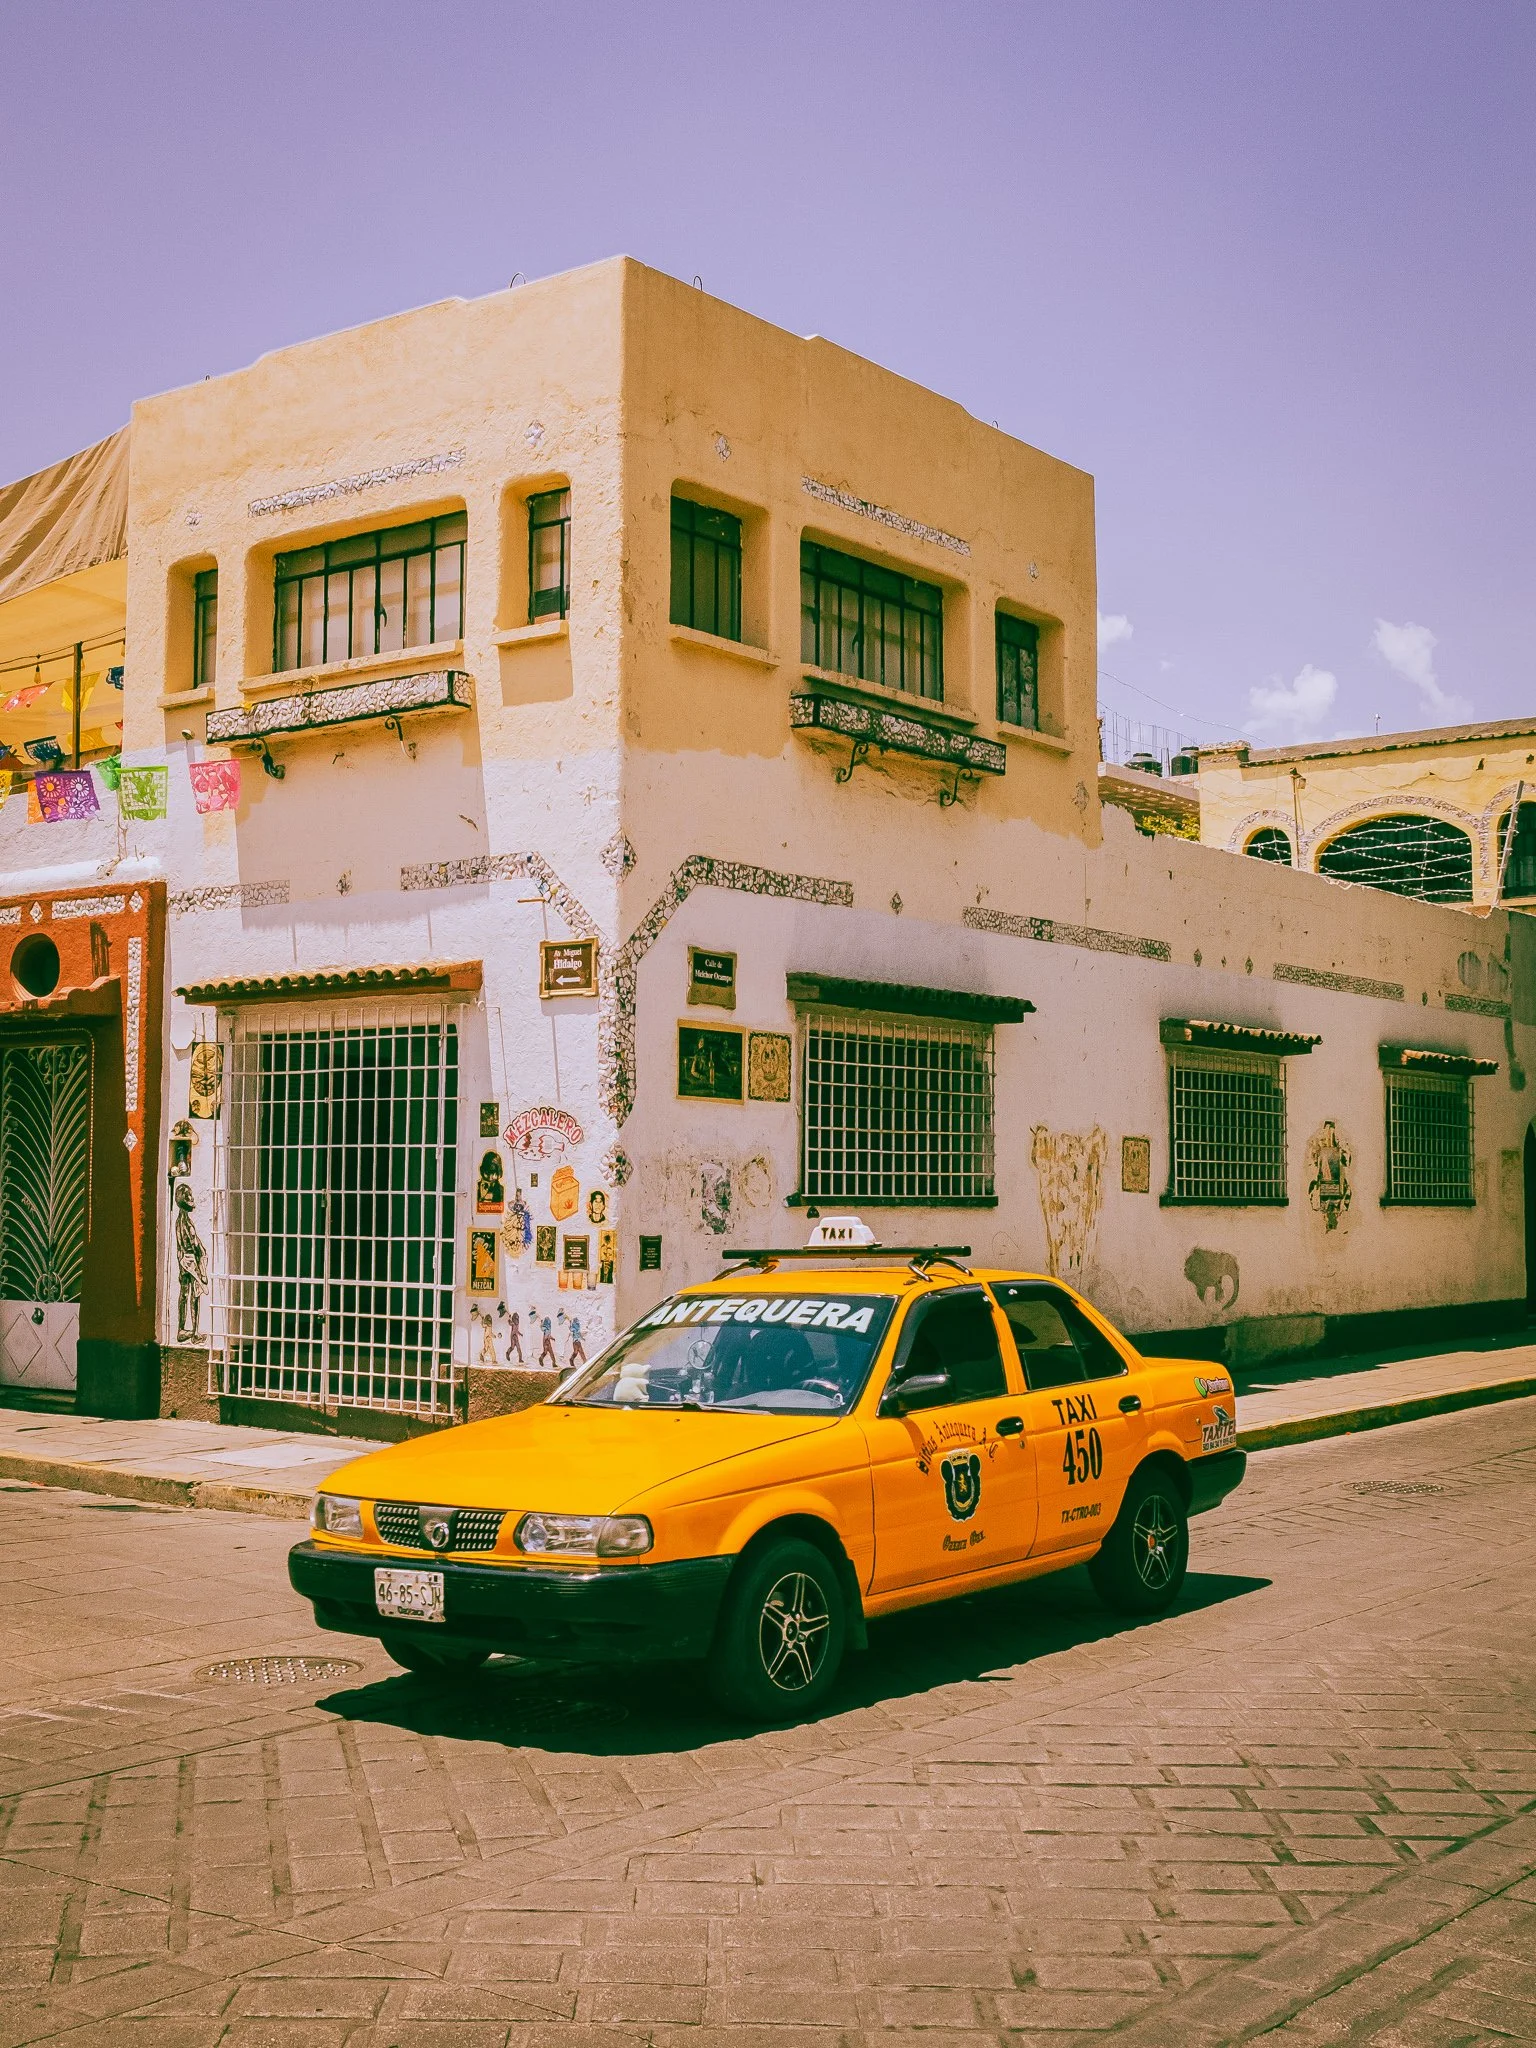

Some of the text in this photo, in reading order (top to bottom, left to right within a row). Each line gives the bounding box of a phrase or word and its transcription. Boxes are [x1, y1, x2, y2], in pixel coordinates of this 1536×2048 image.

[563, 947, 582, 957] Miguel
[554, 958, 582, 970] Hidalgo
[705, 959, 723, 969] Calle de
[694, 969, 732, 984] Melchor Ocampo
[505, 1109, 582, 1147] MEZCALERO
[821, 1227, 854, 1240] TAXI
[637, 1298, 875, 1334] ANTEQUERA
[1052, 1393, 1098, 1425] TAXI
[1062, 1427, 1102, 1485] 450
